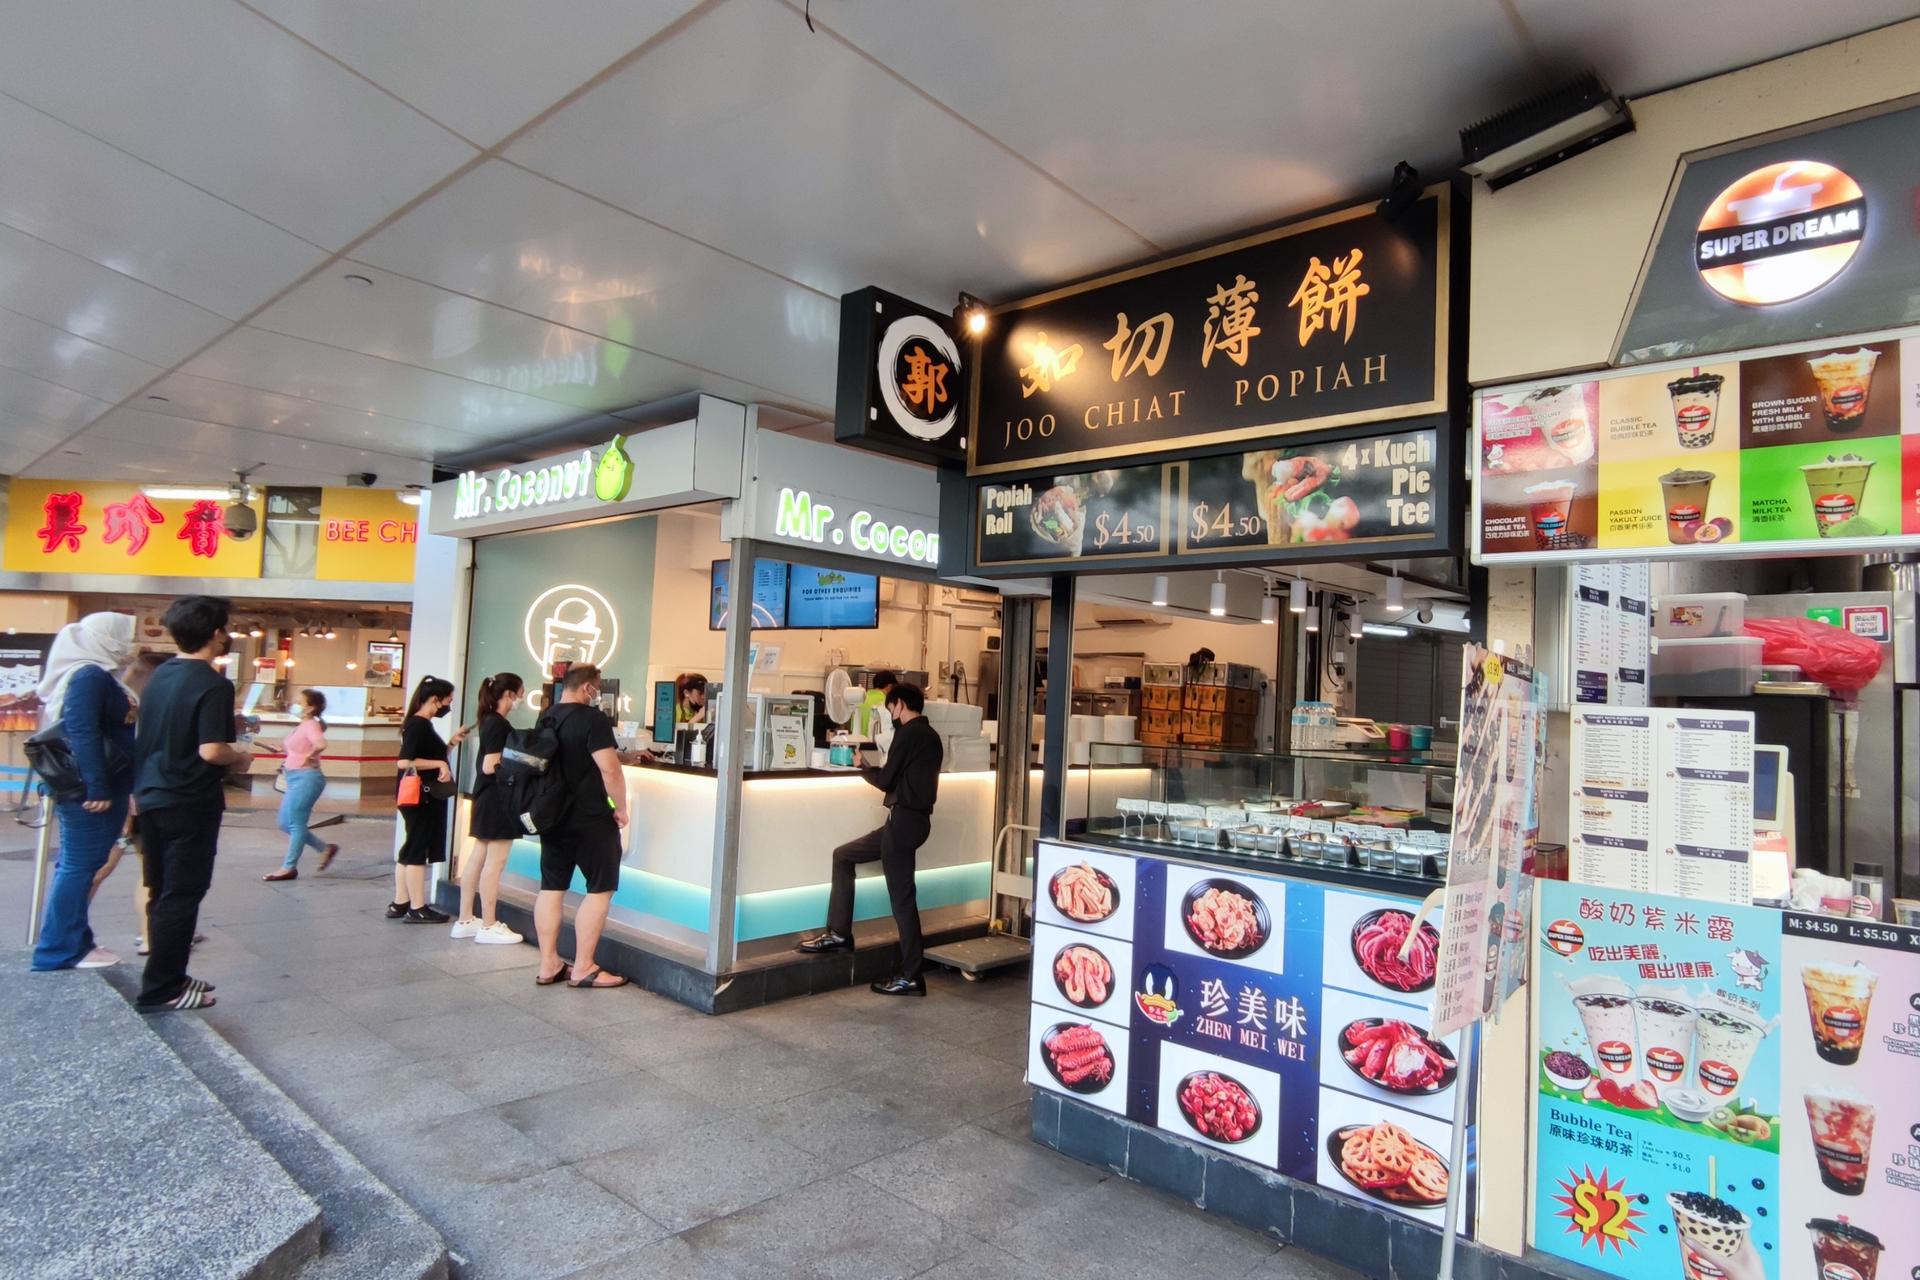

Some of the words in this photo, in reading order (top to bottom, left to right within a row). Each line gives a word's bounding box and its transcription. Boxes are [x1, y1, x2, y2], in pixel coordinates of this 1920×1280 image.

[1700, 229, 1769, 260] SUPER
[1772, 208, 1861, 246] DREAM
[1018, 248, 1370, 399] 如切薄餅
[902, 346, 949, 414] 郭
[1003, 414, 1056, 449] JOO
[1084, 390, 1186, 430] CHIAT
[1234, 354, 1389, 406] POPIAH
[1752, 399, 1785, 409] BROWN
[1786, 395, 1817, 405] SUGAR
[1752, 407, 1781, 416] FRESH
[1782, 405, 1803, 414] MILK
[1610, 416, 1643, 425] CLASSIC
[1610, 424, 1641, 433] BUBBLE
[1752, 416, 1775, 425] WITH
[1776, 413, 1811, 422] BUBBLE
[1342, 443, 1358, 470] 4
[1374, 435, 1431, 468] Kueh
[453, 470, 492, 520] Mr.
[495, 450, 592, 512] Coconut
[1392, 466, 1430, 497] Pie
[986, 484, 1032, 510] Popiah
[1386, 497, 1430, 527] Tee
[1609, 508, 1642, 516] PASSION
[1752, 498, 1788, 507] MATCHA
[37, 491, 231, 558] 美珍香
[326, 519, 369, 542] BEE
[377, 520, 417, 543] CH
[776, 488, 844, 545] Mr.
[850, 511, 939, 564] Cocon
[985, 512, 1013, 536] Roll
[1094, 511, 1155, 548] $4.50
[1190, 501, 1261, 540] $4.50
[1485, 516, 1526, 525] CHOCOLATE
[1485, 524, 1512, 532] BUBBLE
[1609, 516, 1637, 524] YAKULT
[1639, 514, 1662, 522] JUICE
[1579, 897, 1735, 942] 酸奶紫米露
[1788, 918, 1803, 929] M:
[1805, 920, 1838, 934] $4.50
[1849, 926, 1861, 937] L:
[1863, 927, 1898, 942] $5.50
[1909, 934, 1920, 945] X
[1548, 932, 1564, 940] SUPER
[1200, 978, 1308, 1039] 珍美味
[1196, 1015, 1232, 1041] ZHEN
[1240, 1028, 1267, 1050] MEI
[1277, 1038, 1306, 1061] WEI
[1550, 1108, 1602, 1132] Bubble
[1606, 1122, 1633, 1140] Tea
[1549, 1124, 1634, 1157] 原味珍珠奶茶
[1672, 1151, 1691, 1161] $0.5
[1672, 1162, 1691, 1174] $1.0
[1572, 1177, 1630, 1241] $2
